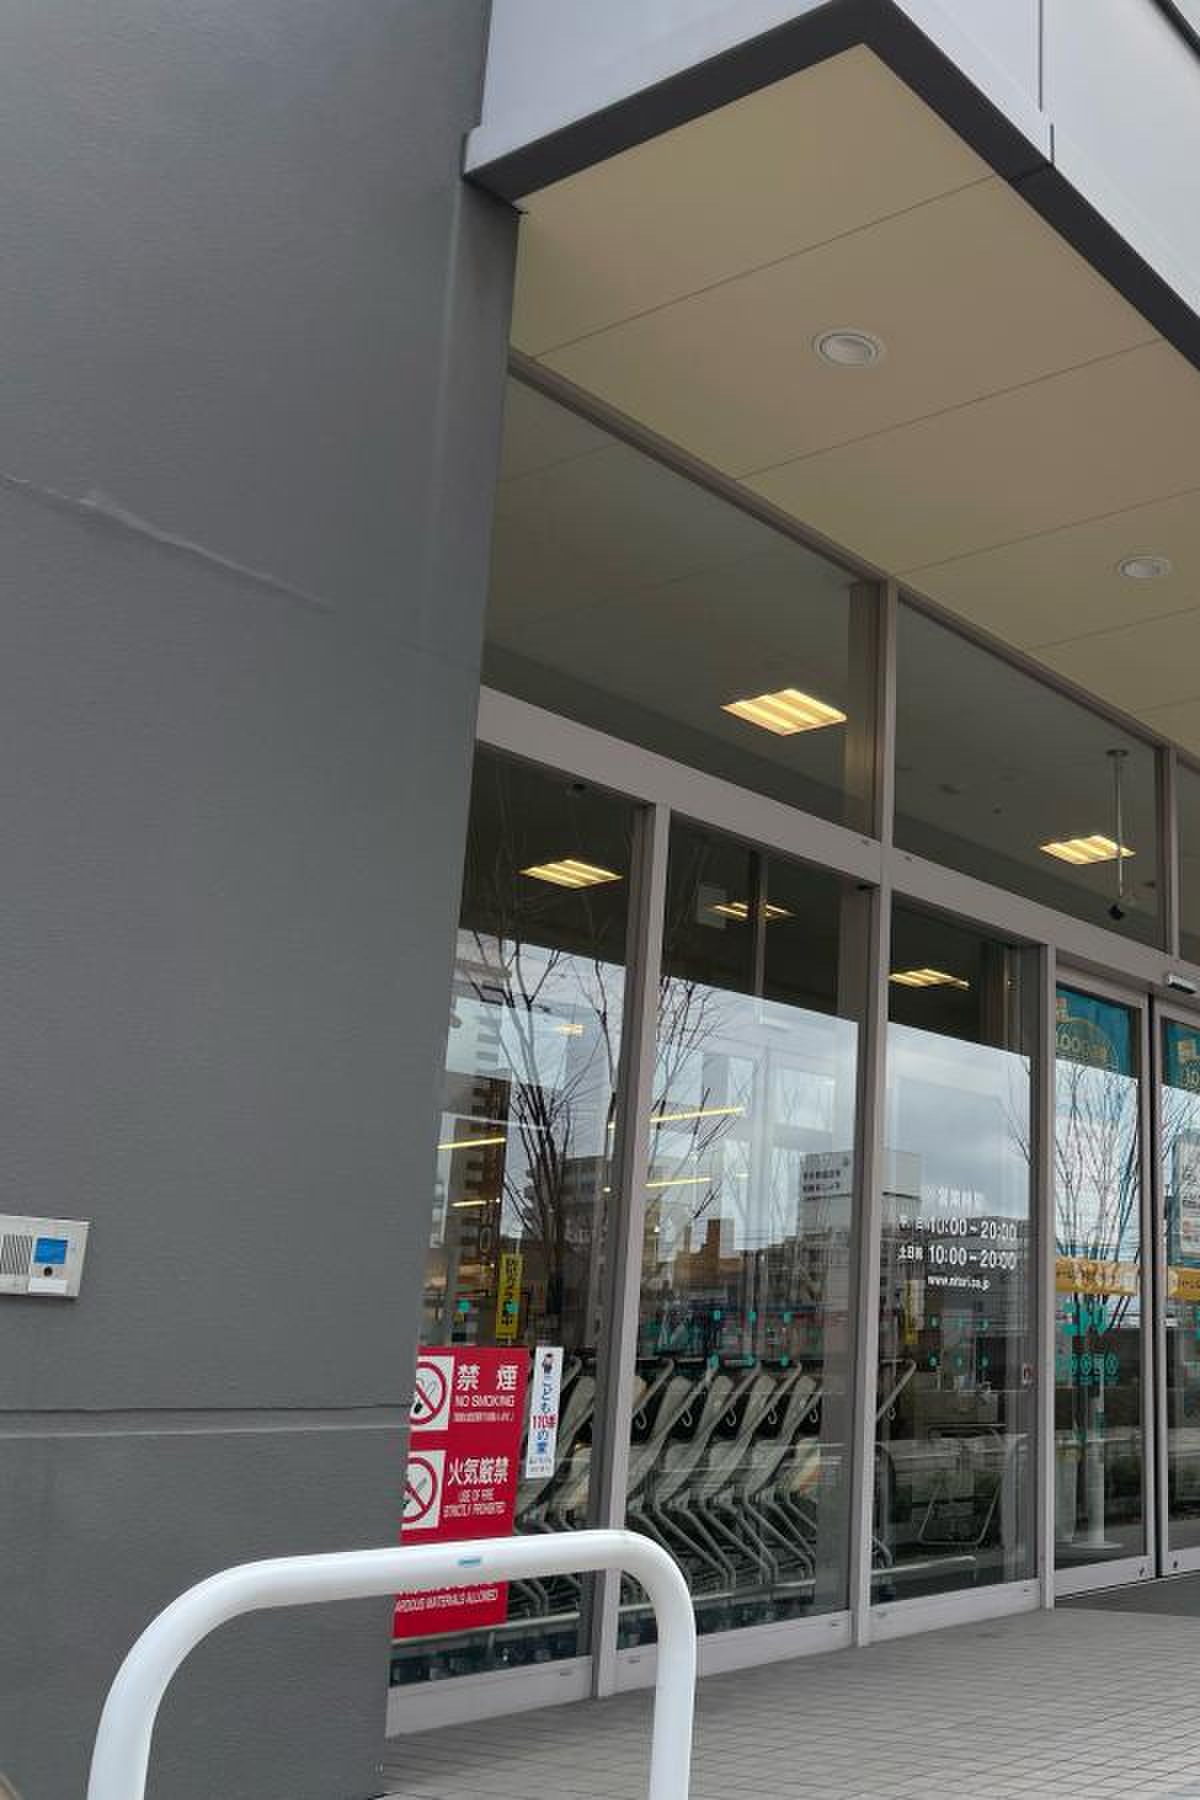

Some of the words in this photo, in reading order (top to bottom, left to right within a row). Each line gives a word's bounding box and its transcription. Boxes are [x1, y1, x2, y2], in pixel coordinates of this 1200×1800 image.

[455, 1394, 470, 1408] NO
[471, 1394, 516, 1408] SMOKING
[447, 1456, 509, 1486] 火気厳禁
